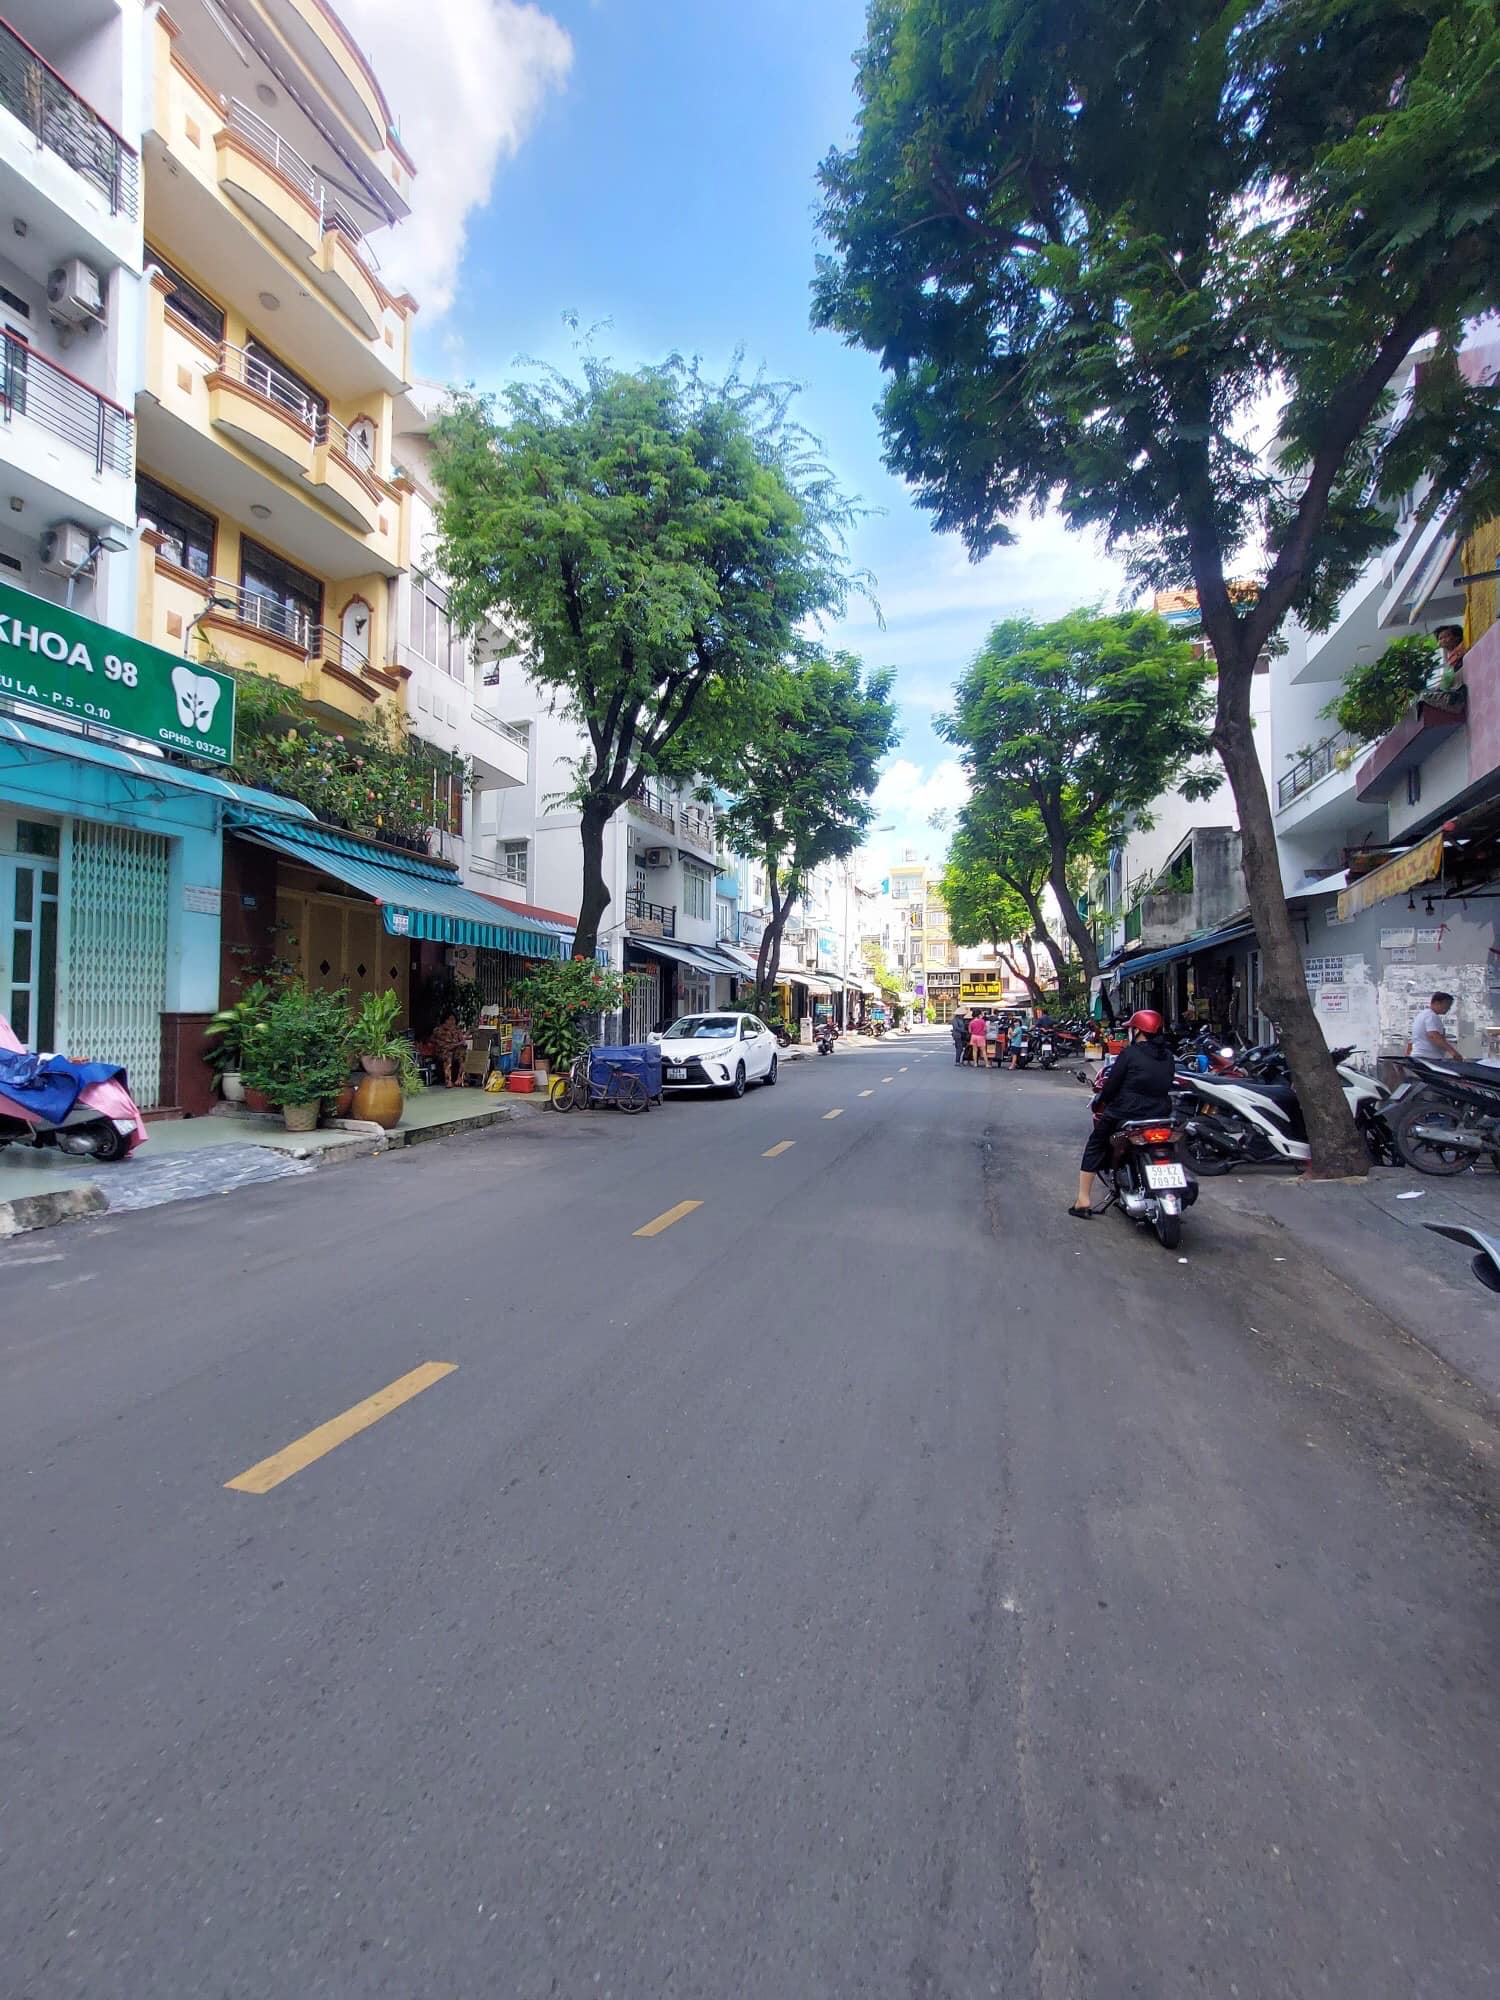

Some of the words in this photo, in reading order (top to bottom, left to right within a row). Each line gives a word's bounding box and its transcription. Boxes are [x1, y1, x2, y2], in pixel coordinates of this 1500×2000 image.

[104, 654, 138, 688] 98
[17, 681, 38, 698] LA
[52, 692, 74, 708] P.5
[84, 703, 111, 720] Q.10
